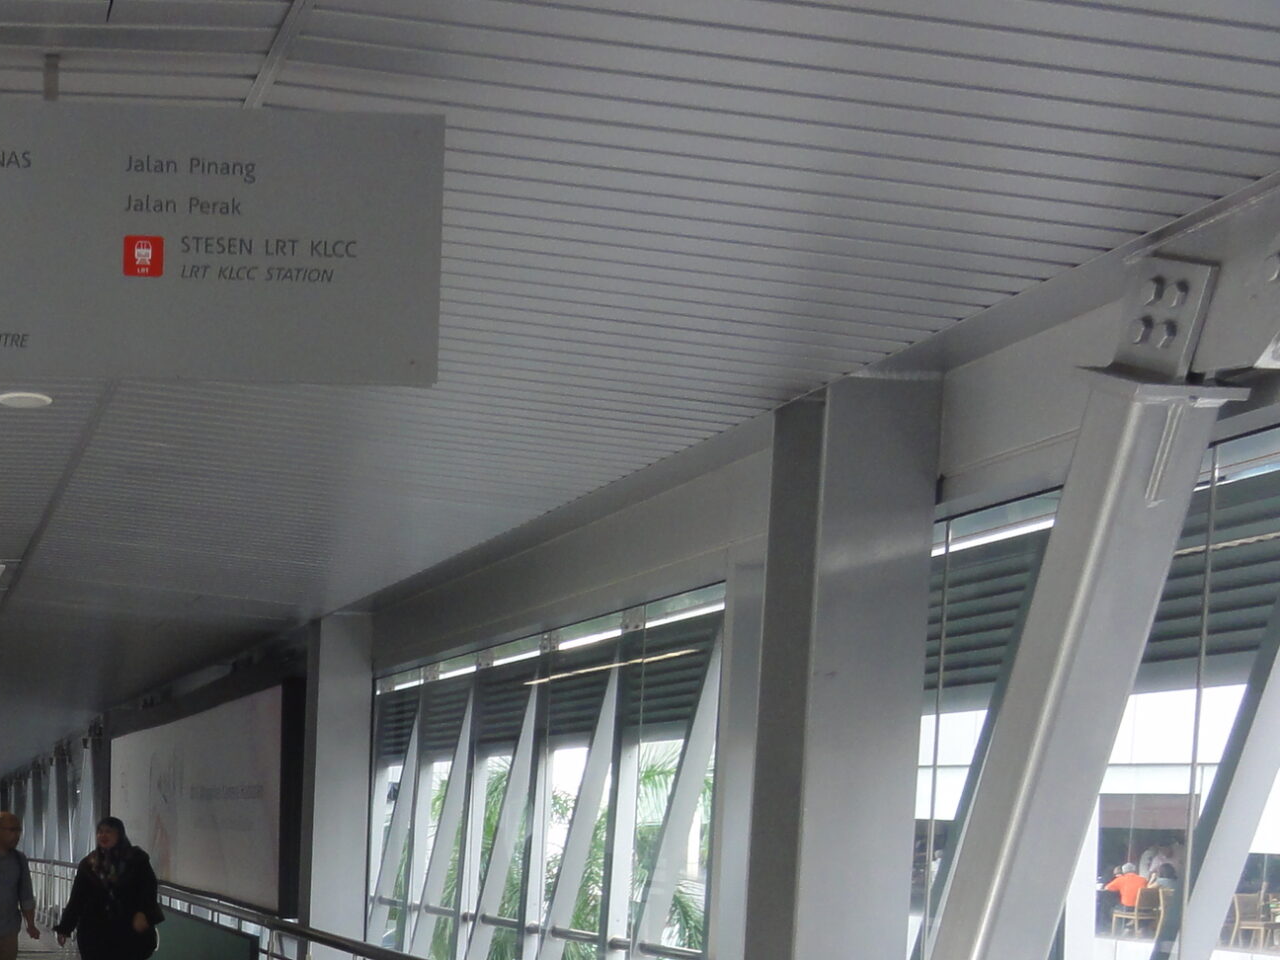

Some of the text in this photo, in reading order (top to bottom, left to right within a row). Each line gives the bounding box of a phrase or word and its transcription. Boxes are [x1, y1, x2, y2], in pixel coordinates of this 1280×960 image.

[126, 155, 256, 184] Jalan Pinang
[125, 194, 241, 215] Jalan Perak
[181, 235, 357, 258] STESEN LRT KLCC
[181, 265, 333, 283] LRT KLCC STATION
